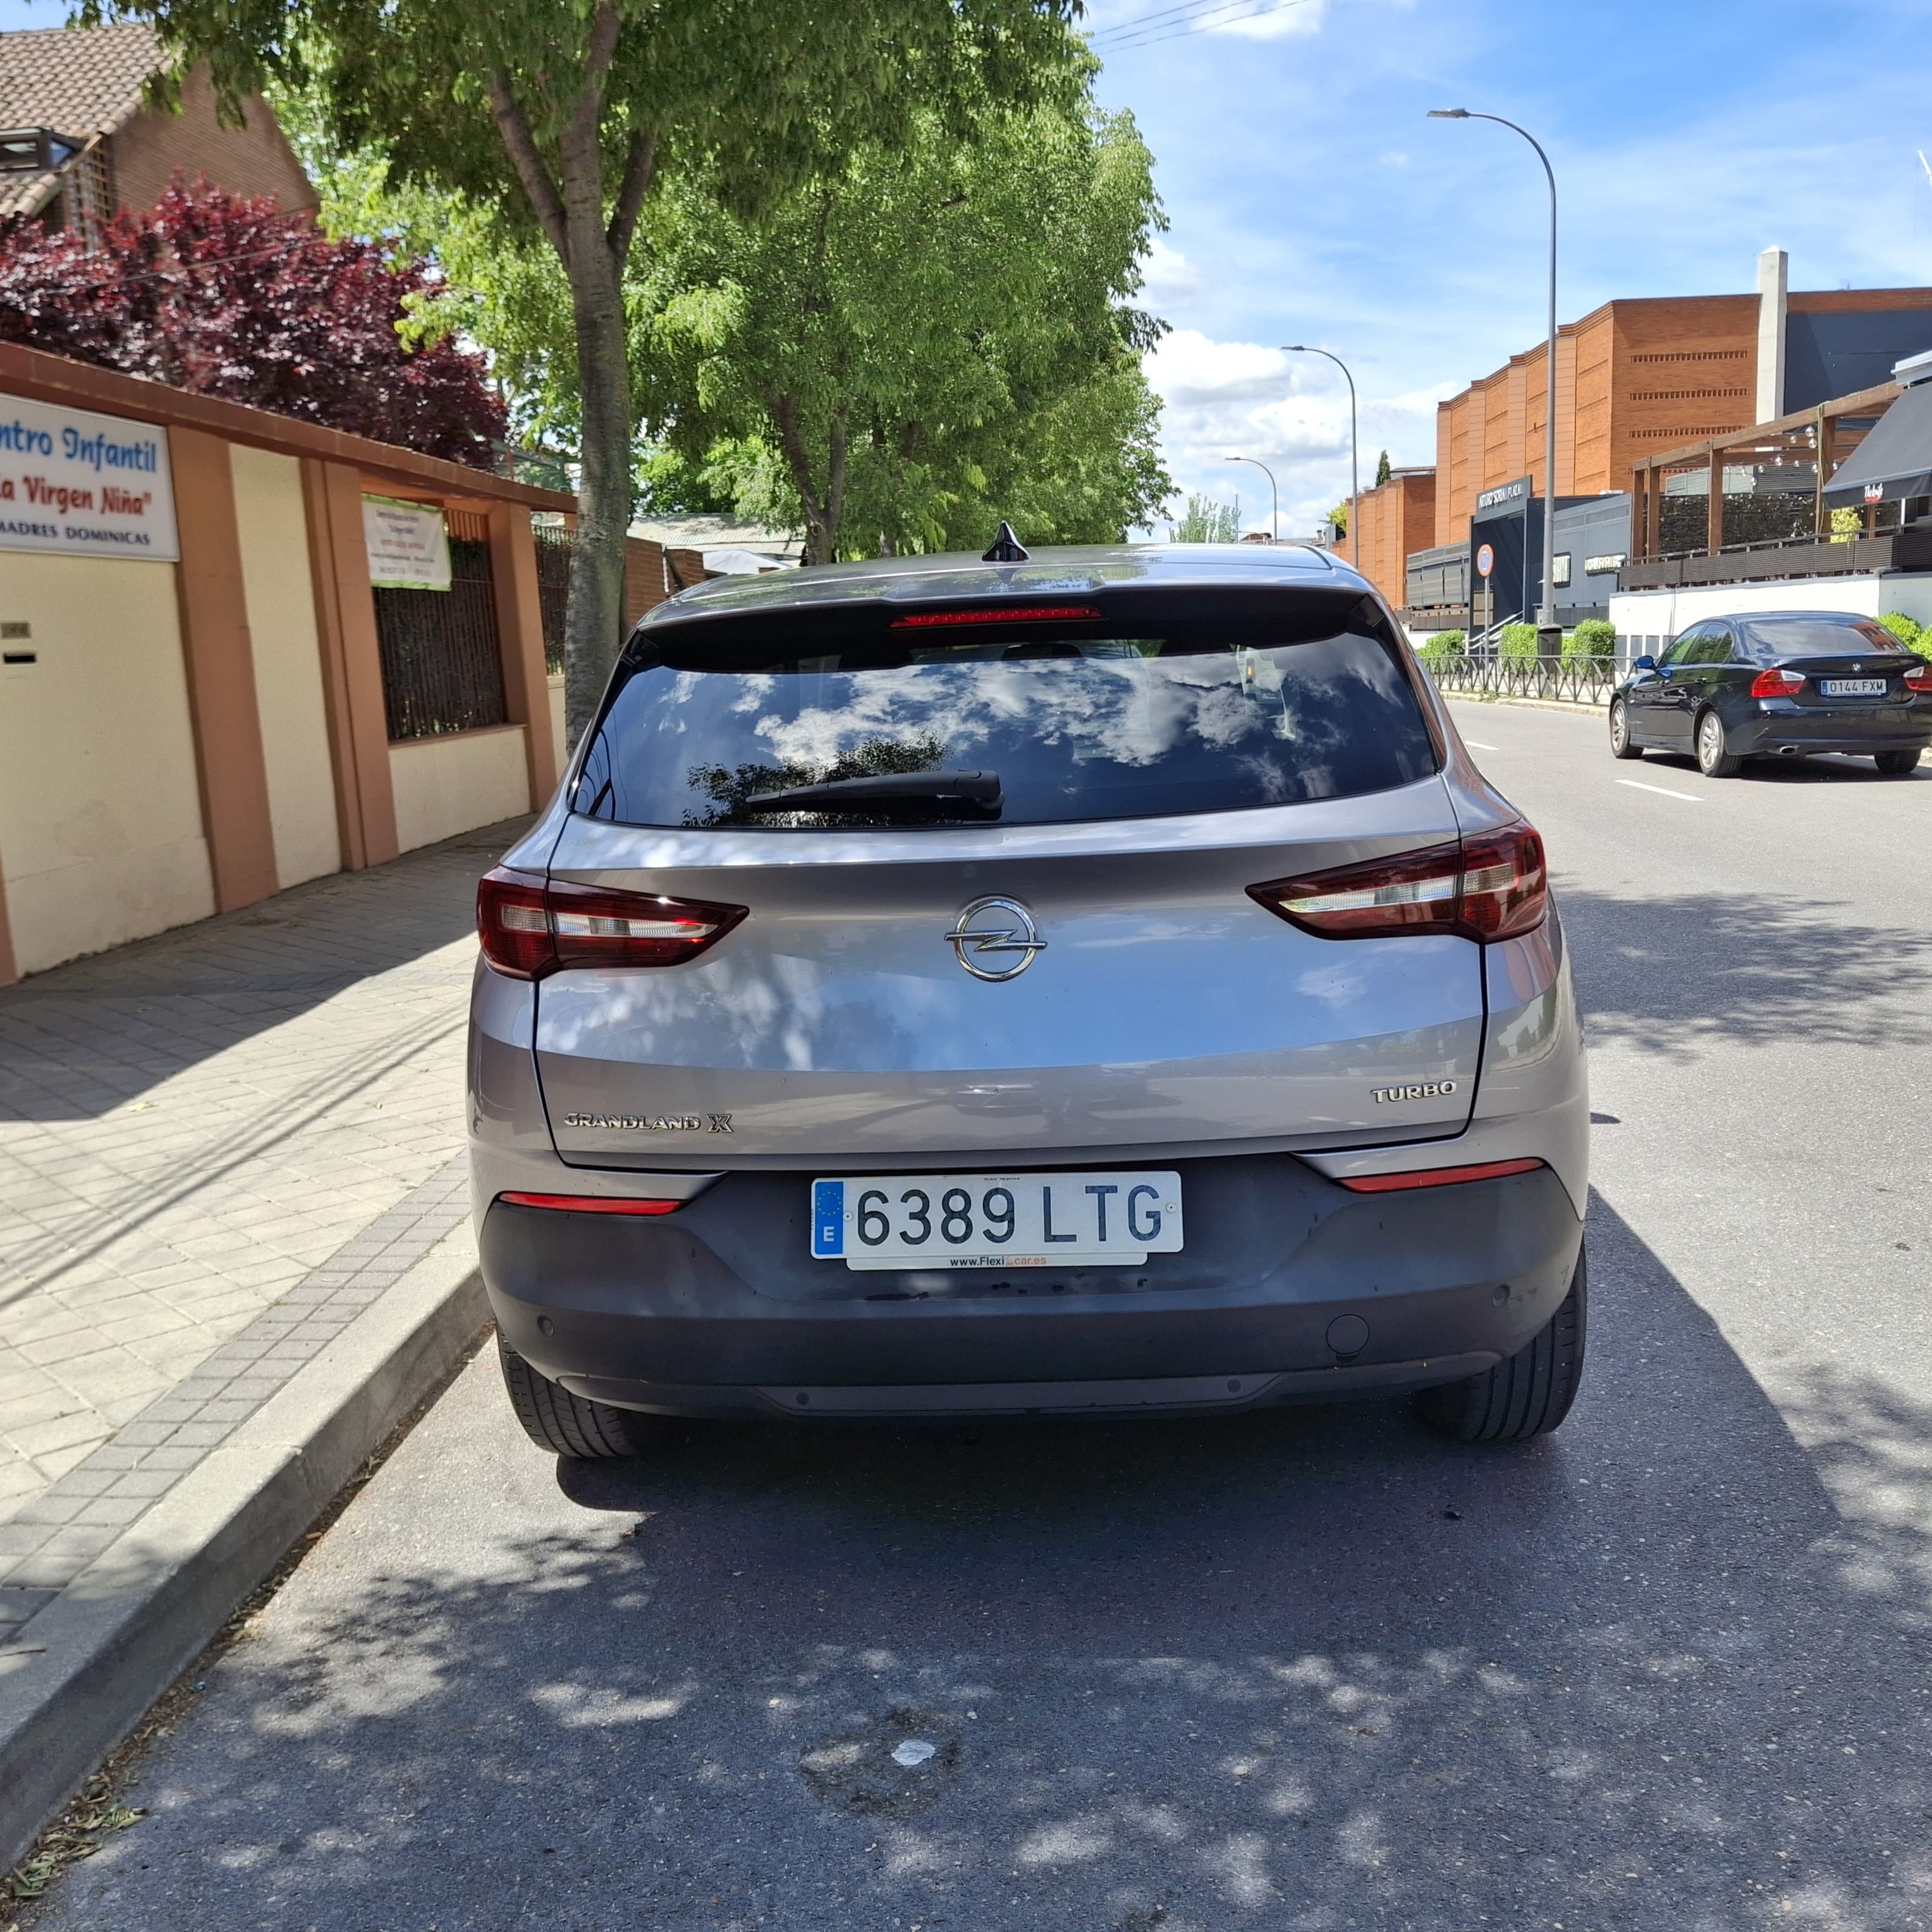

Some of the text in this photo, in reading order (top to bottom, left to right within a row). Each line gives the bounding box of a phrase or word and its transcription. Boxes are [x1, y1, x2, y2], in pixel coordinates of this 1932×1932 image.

[63, 426, 157, 473] Infantil
[0, 480, 15, 501] a
[23, 475, 93, 515] Virgen
[65, 526, 150, 546] DOMINICAS
[1830, 681, 1883, 693] 0144 FXM
[1370, 1079, 1457, 1104] TURBO
[563, 1112, 734, 1134] GRANDLAND X
[823, 1183, 1163, 1247] E 6389 LTG
